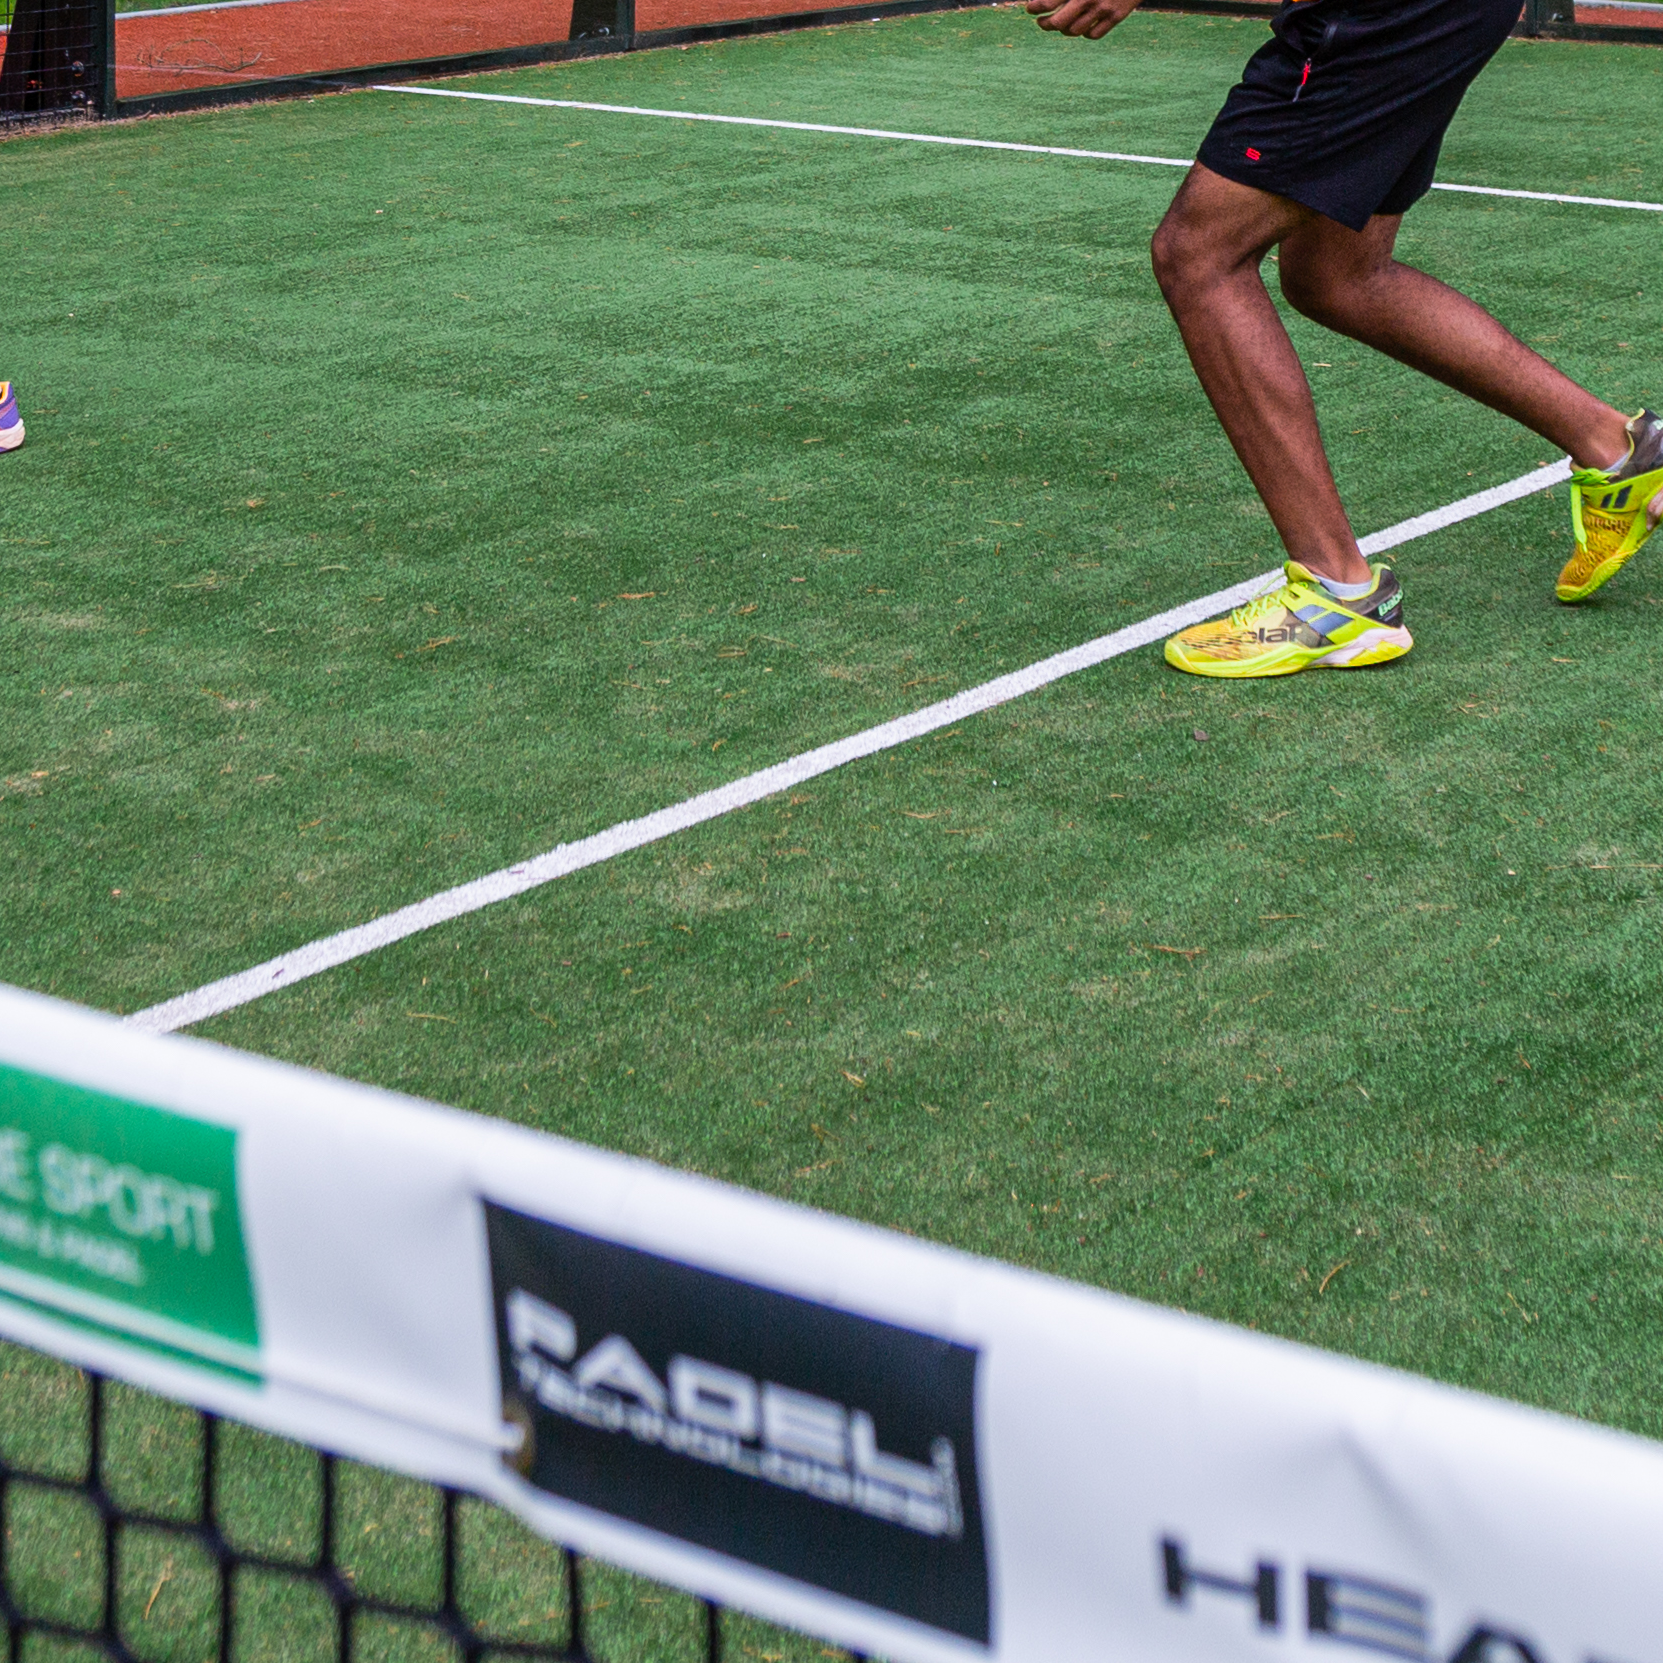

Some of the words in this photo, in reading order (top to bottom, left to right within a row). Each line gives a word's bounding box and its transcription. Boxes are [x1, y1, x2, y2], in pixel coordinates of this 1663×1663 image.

[38, 1141, 220, 1257] SPORT
[505, 1284, 941, 1501] PADEL
[512, 1346, 952, 1538] TECHNOLOGIES
